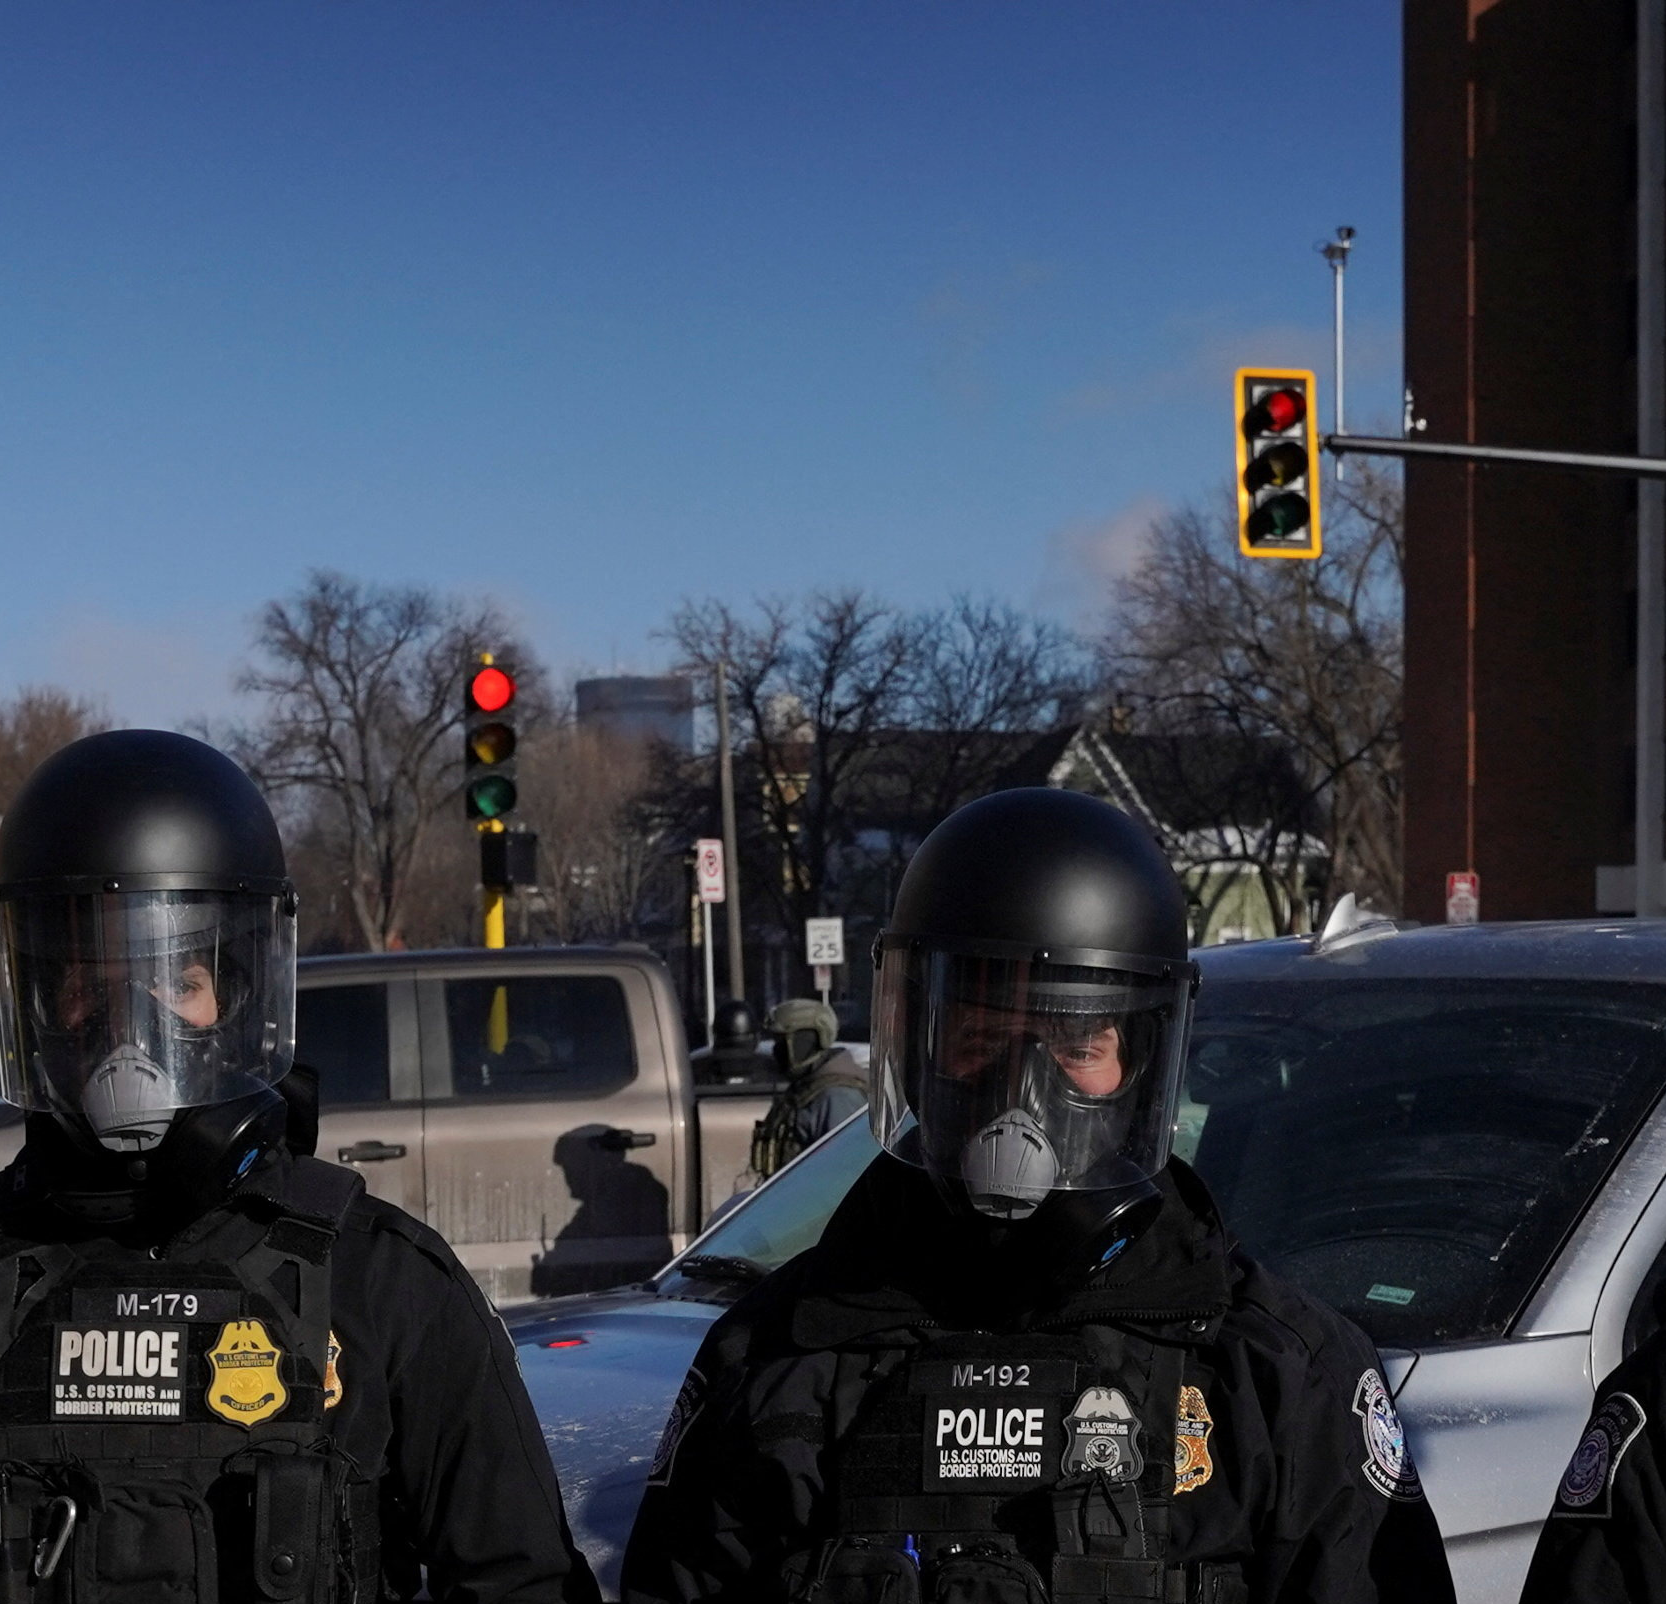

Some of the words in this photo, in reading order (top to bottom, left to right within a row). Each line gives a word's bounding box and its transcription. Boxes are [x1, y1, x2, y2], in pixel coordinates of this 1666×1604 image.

[813, 943, 839, 959] 25
[116, 1293, 199, 1317] M-179
[58, 1329, 179, 1378] POLICE
[951, 1364, 1031, 1388] M-192
[54, 1384, 83, 1399] U.S.
[86, 1384, 156, 1399] CUSTOMS
[159, 1388, 181, 1400] AND
[54, 1401, 103, 1416] BORDER
[105, 1401, 181, 1416] PROTECTION
[231, 1400, 265, 1411] OFFICER
[935, 1408, 1045, 1447] POLICE
[1076, 1427, 1096, 1435] BORDER
[1091, 1421, 1118, 1429] CUSTOMS
[1192, 1422, 1205, 1430] AND
[963, 1449, 1016, 1464] CUSTOMS
[1016, 1452, 1041, 1463] AND
[939, 1463, 979, 1478] BORDER
[980, 1463, 1041, 1478] PROTECTION
